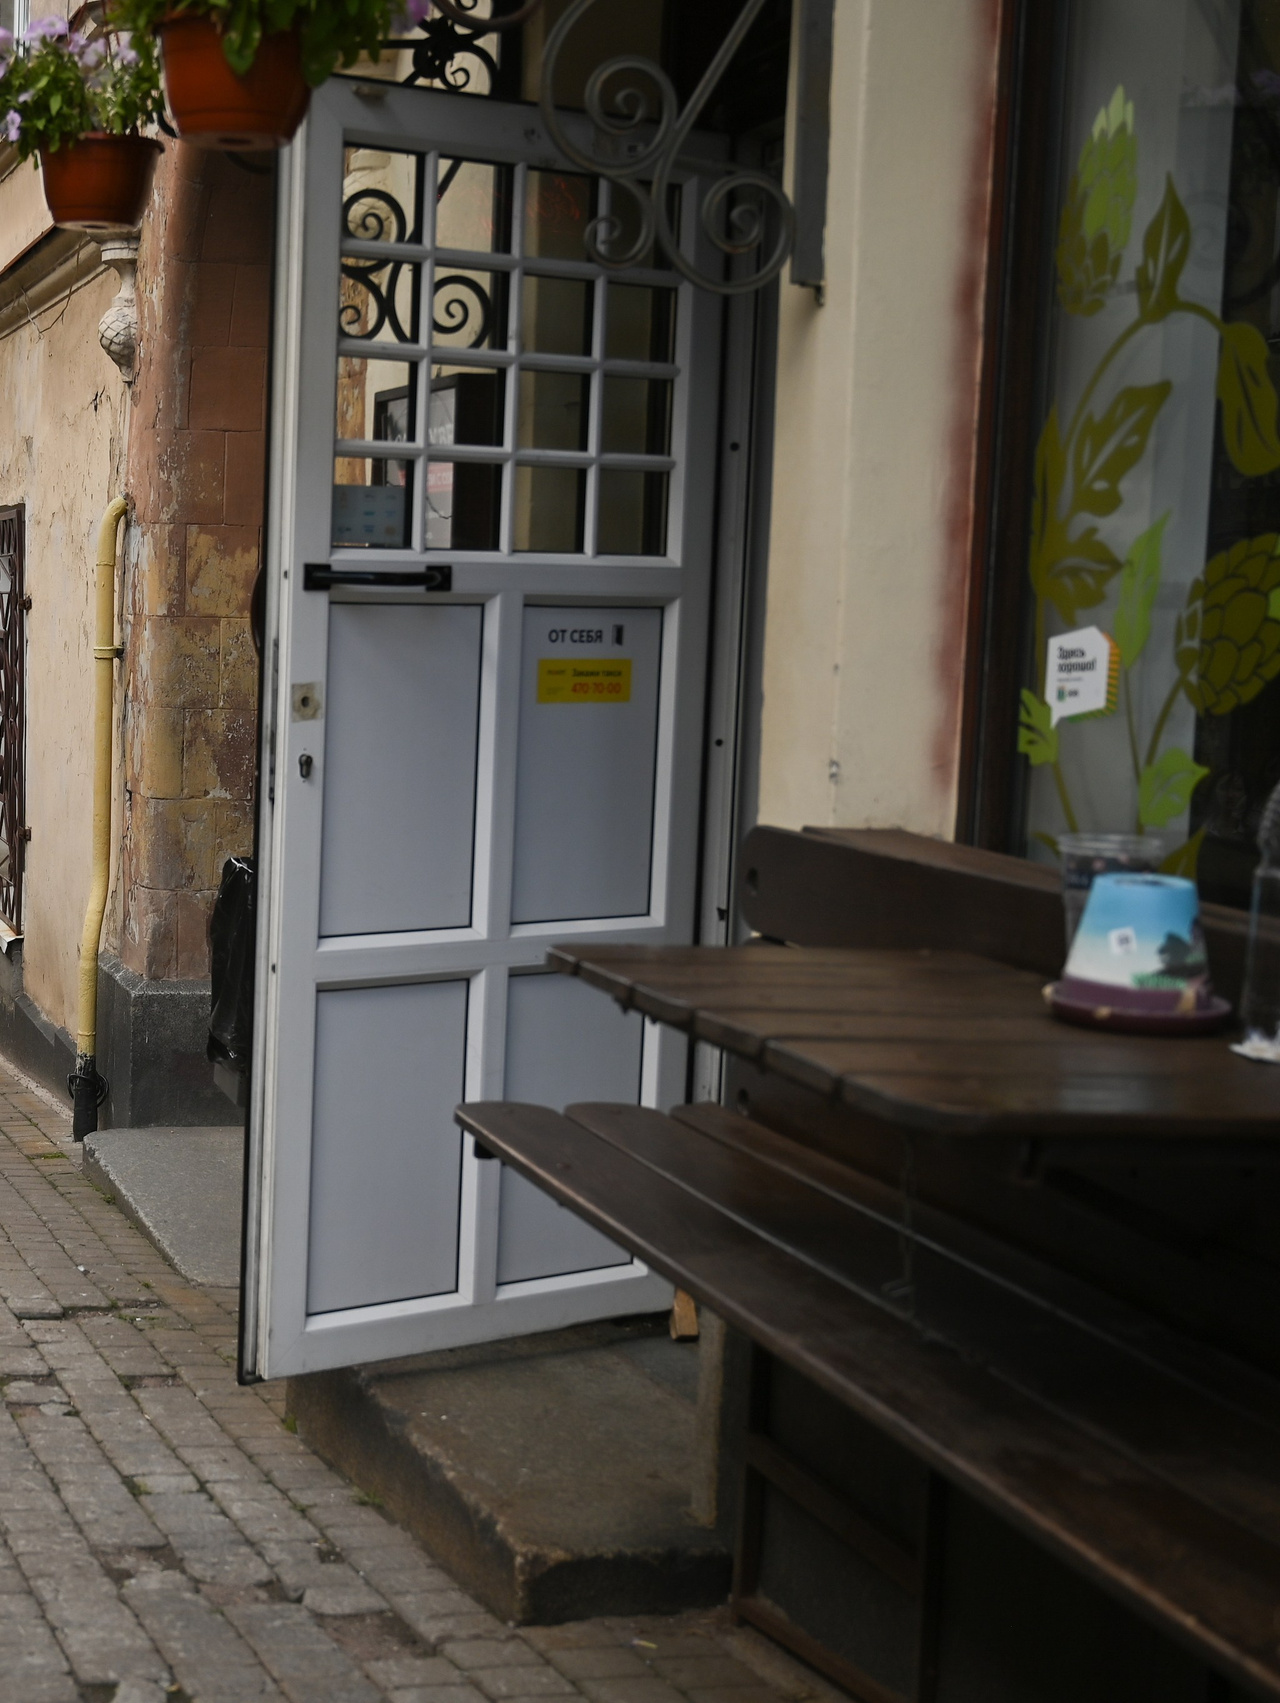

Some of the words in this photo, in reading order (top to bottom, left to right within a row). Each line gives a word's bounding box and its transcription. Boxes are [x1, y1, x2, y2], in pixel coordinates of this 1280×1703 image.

[548, 629, 567, 643] ОТ
[570, 629, 603, 643] СЕБЯ
[1057, 646, 1086, 660] Здесь
